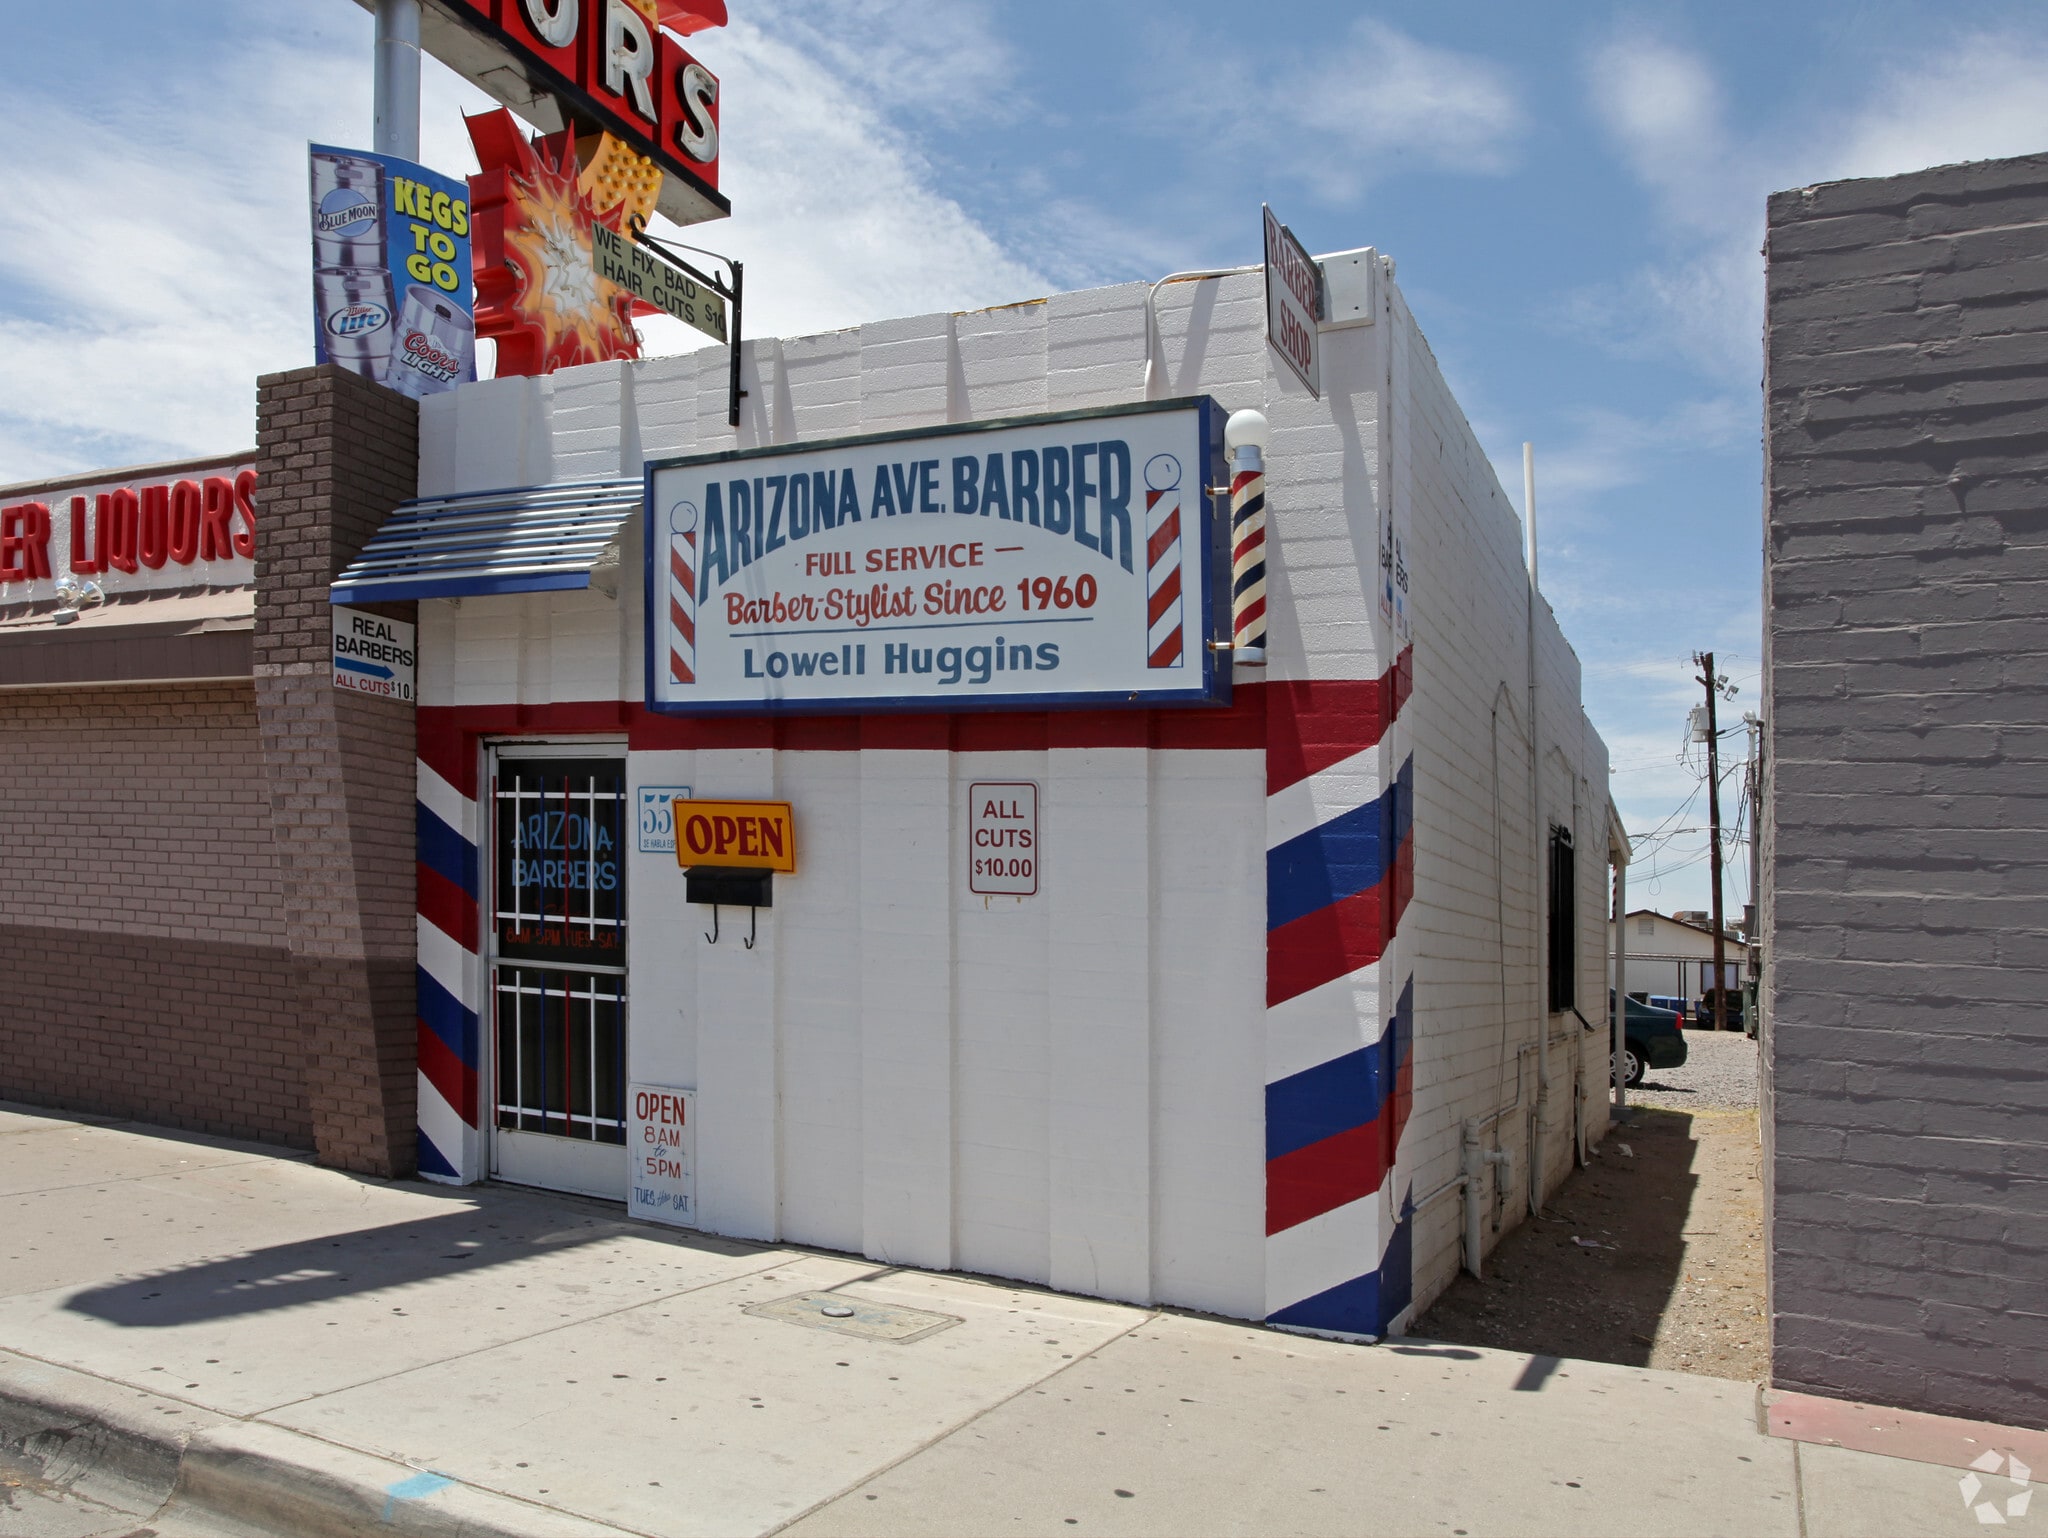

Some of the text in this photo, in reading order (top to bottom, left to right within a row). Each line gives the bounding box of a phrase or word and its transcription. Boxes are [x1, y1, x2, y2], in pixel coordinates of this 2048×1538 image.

[319, 206, 376, 231] BLUE MOON
[394, 176, 470, 237] KEGS
[410, 224, 457, 262] TO
[406, 254, 460, 292] GO
[594, 223, 696, 300] WE FIX BAD
[1268, 218, 1317, 324] BARBER
[603, 255, 643, 296] HAIR
[653, 285, 695, 323] CUTS
[339, 313, 381, 335] Lite
[344, 306, 373, 317] Miller
[403, 328, 459, 373] Coors
[1280, 298, 1312, 375] SHOP
[401, 352, 457, 382] LIGHT
[0, 470, 257, 583] ER LIQUORS
[699, 439, 1135, 607] ARIZONA AVE. BARBER
[805, 542, 984, 577] FULL SERVICE
[923, 578, 1007, 616] Since
[1017, 573, 1098, 612] 1960
[353, 616, 397, 643] REAL
[335, 634, 413, 667] BARBERS
[744, 636, 1060, 685] Lowell Huggins
[335, 674, 356, 688] ALL
[360, 678, 390, 694] CUTS
[643, 793, 684, 834] 55
[982, 800, 1024, 818] ALL
[510, 811, 614, 851] ARIZONA
[686, 814, 783, 857] OPEN
[975, 828, 1032, 848] CUTS
[511, 859, 617, 890] BARBERS
[975, 858, 1032, 877] $10.00
[636, 1091, 685, 1126] OPEN
[644, 1126, 681, 1147] 8AM
[653, 1144, 667, 1157] to
[646, 1157, 682, 1179] 5PM
